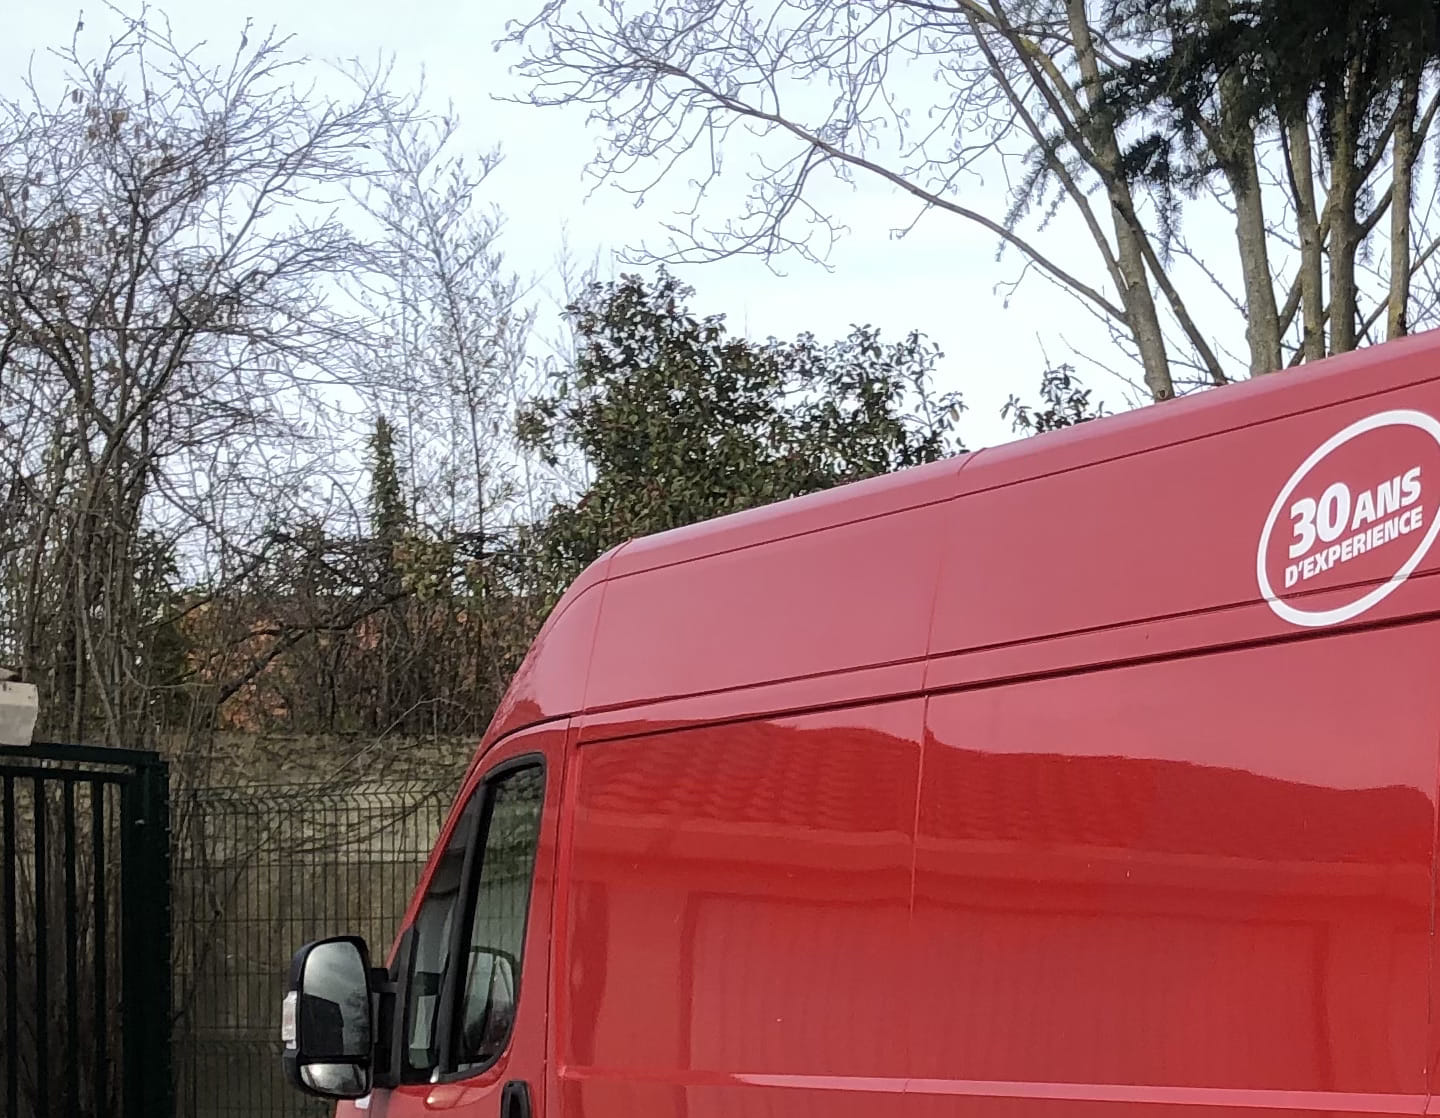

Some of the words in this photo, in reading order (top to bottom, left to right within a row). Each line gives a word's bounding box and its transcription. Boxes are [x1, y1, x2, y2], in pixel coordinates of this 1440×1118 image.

[1285, 505, 1423, 588] D'EXPERIENCE
[1288, 482, 1350, 559] 30
[1351, 466, 1421, 531] ANS
